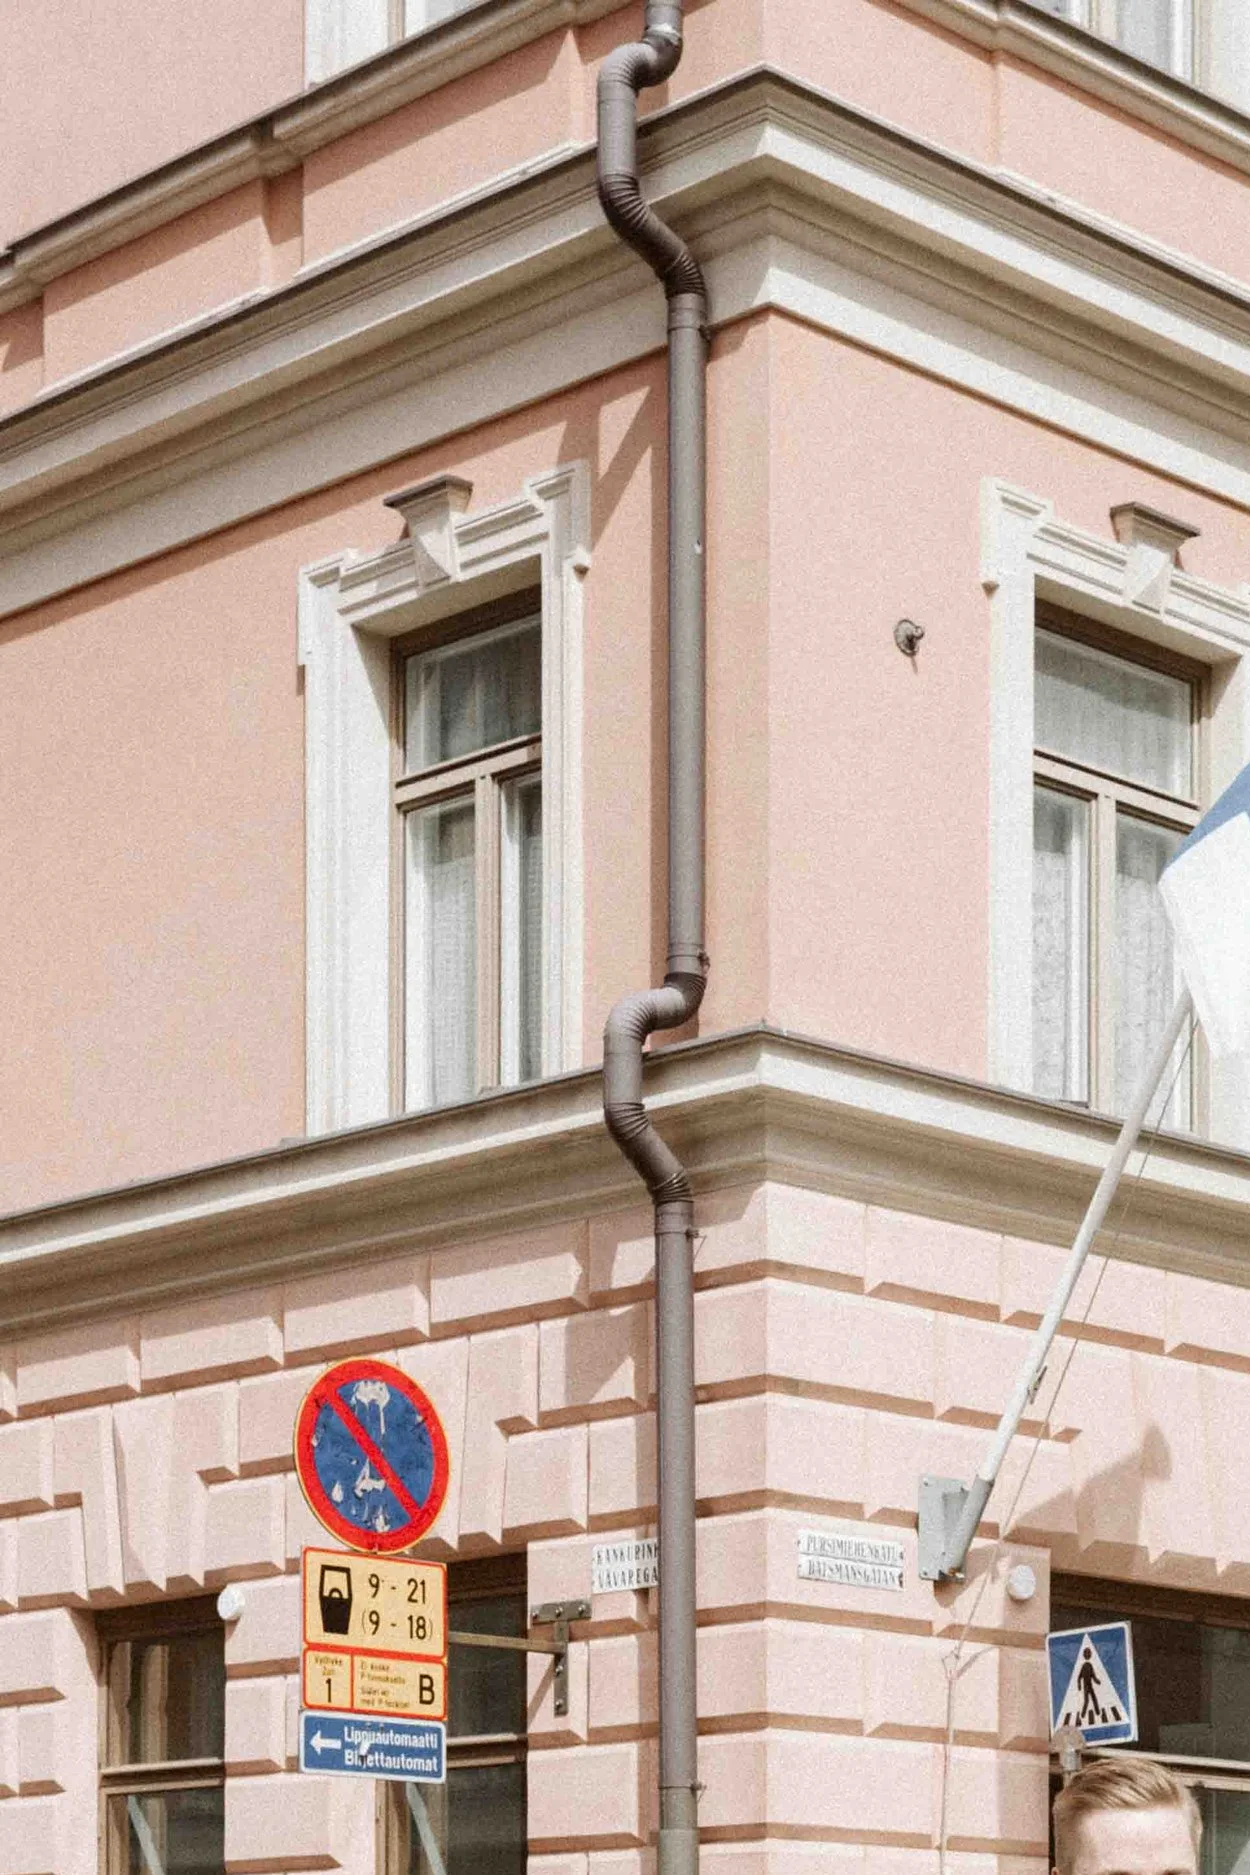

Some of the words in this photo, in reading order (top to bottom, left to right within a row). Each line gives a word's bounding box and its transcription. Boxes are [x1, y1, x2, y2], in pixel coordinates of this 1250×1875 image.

[368, 1573, 380, 1598] 9
[407, 1578, 426, 1604] 21
[361, 1609, 380, 1636] (9
[407, 1615, 433, 1640] 18)
[325, 1678, 332, 1703] 1
[419, 1674, 435, 1705] B
[343, 1726, 438, 1749] Lippuautomaatti
